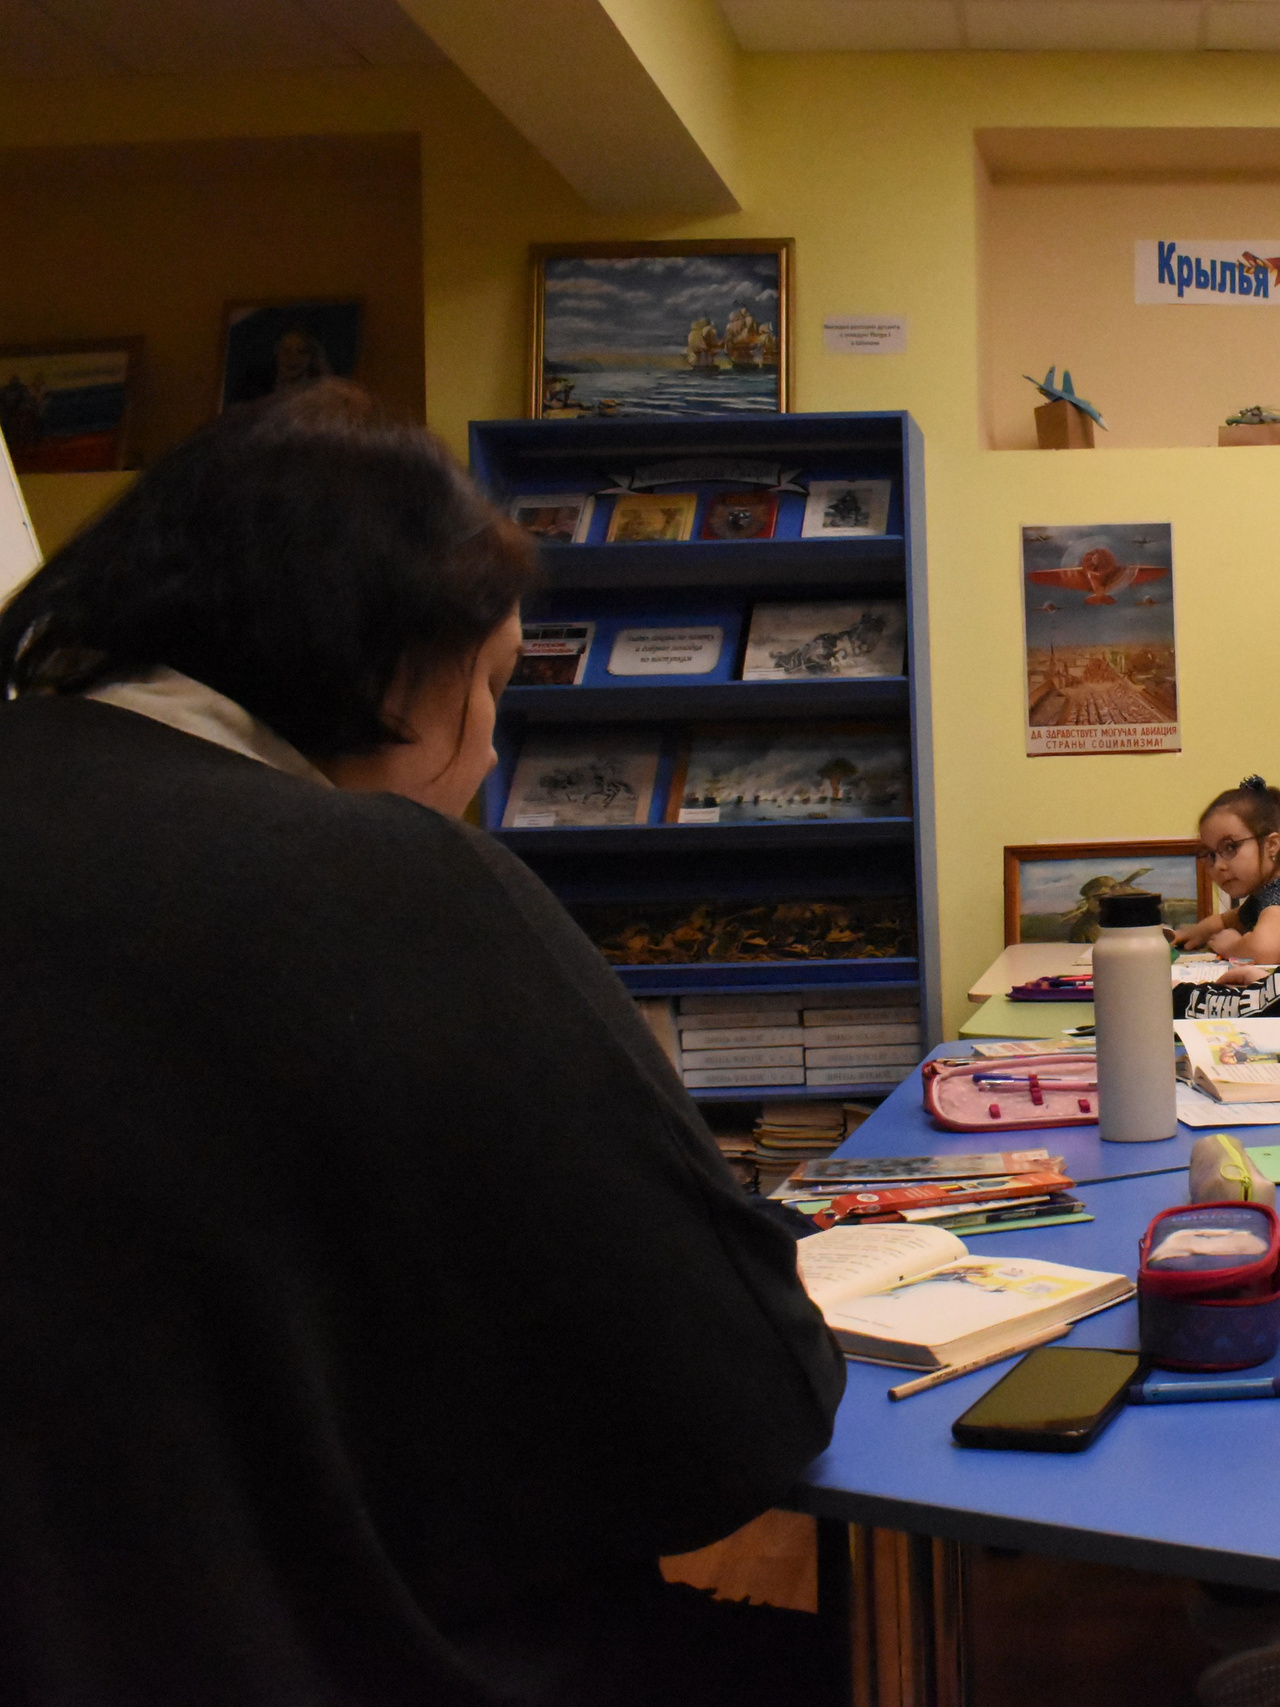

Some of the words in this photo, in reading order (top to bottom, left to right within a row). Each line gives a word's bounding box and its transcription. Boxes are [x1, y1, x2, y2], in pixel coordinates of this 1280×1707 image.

[1157, 240, 1269, 299] Крылья
[1031, 730, 1042, 740] ДА
[1045, 729, 1098, 739] ЗДРАВСТВУЕТ
[1101, 727, 1137, 738] МОГУЧАЯ
[1141, 726, 1177, 737] АВИАЦИЯ
[1046, 740, 1086, 749] СТРАНЫ
[1092, 738, 1163, 749] СОЦИАЛИЗМА!
